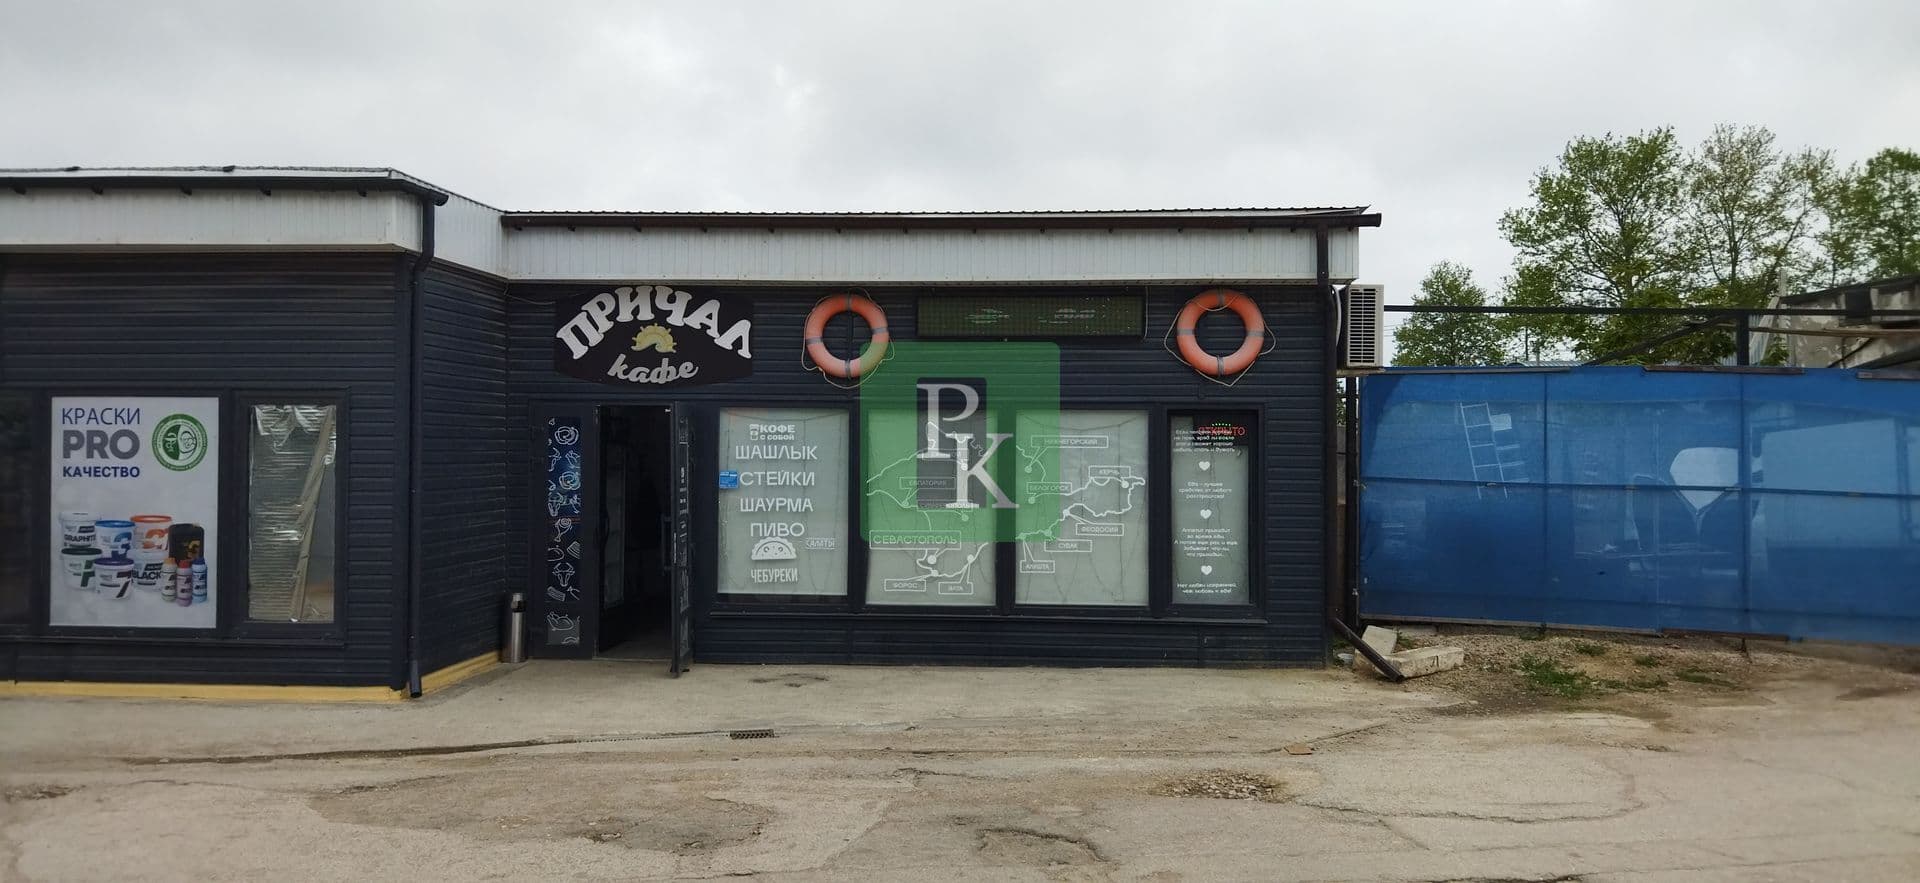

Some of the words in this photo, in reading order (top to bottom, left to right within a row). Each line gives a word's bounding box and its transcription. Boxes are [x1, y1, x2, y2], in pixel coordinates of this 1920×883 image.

[556, 286, 752, 359] ПРИЧАЛ
[607, 354, 699, 384] кафе
[62, 408, 140, 425] КРАСКИ
[760, 424, 796, 433] КОФЕ
[63, 429, 140, 460] PRO
[735, 445, 818, 460] ШАШЛЫК
[63, 466, 140, 478] КАЧЕСТВО
[739, 470, 815, 486] СТЕЙКИ
[740, 498, 814, 512] ШАУРМА
[750, 523, 805, 537] ПИВО
[873, 535, 958, 545] СЕВАСТОПОЛЬ
[751, 568, 799, 583] ЧЕБУРЕКИ
